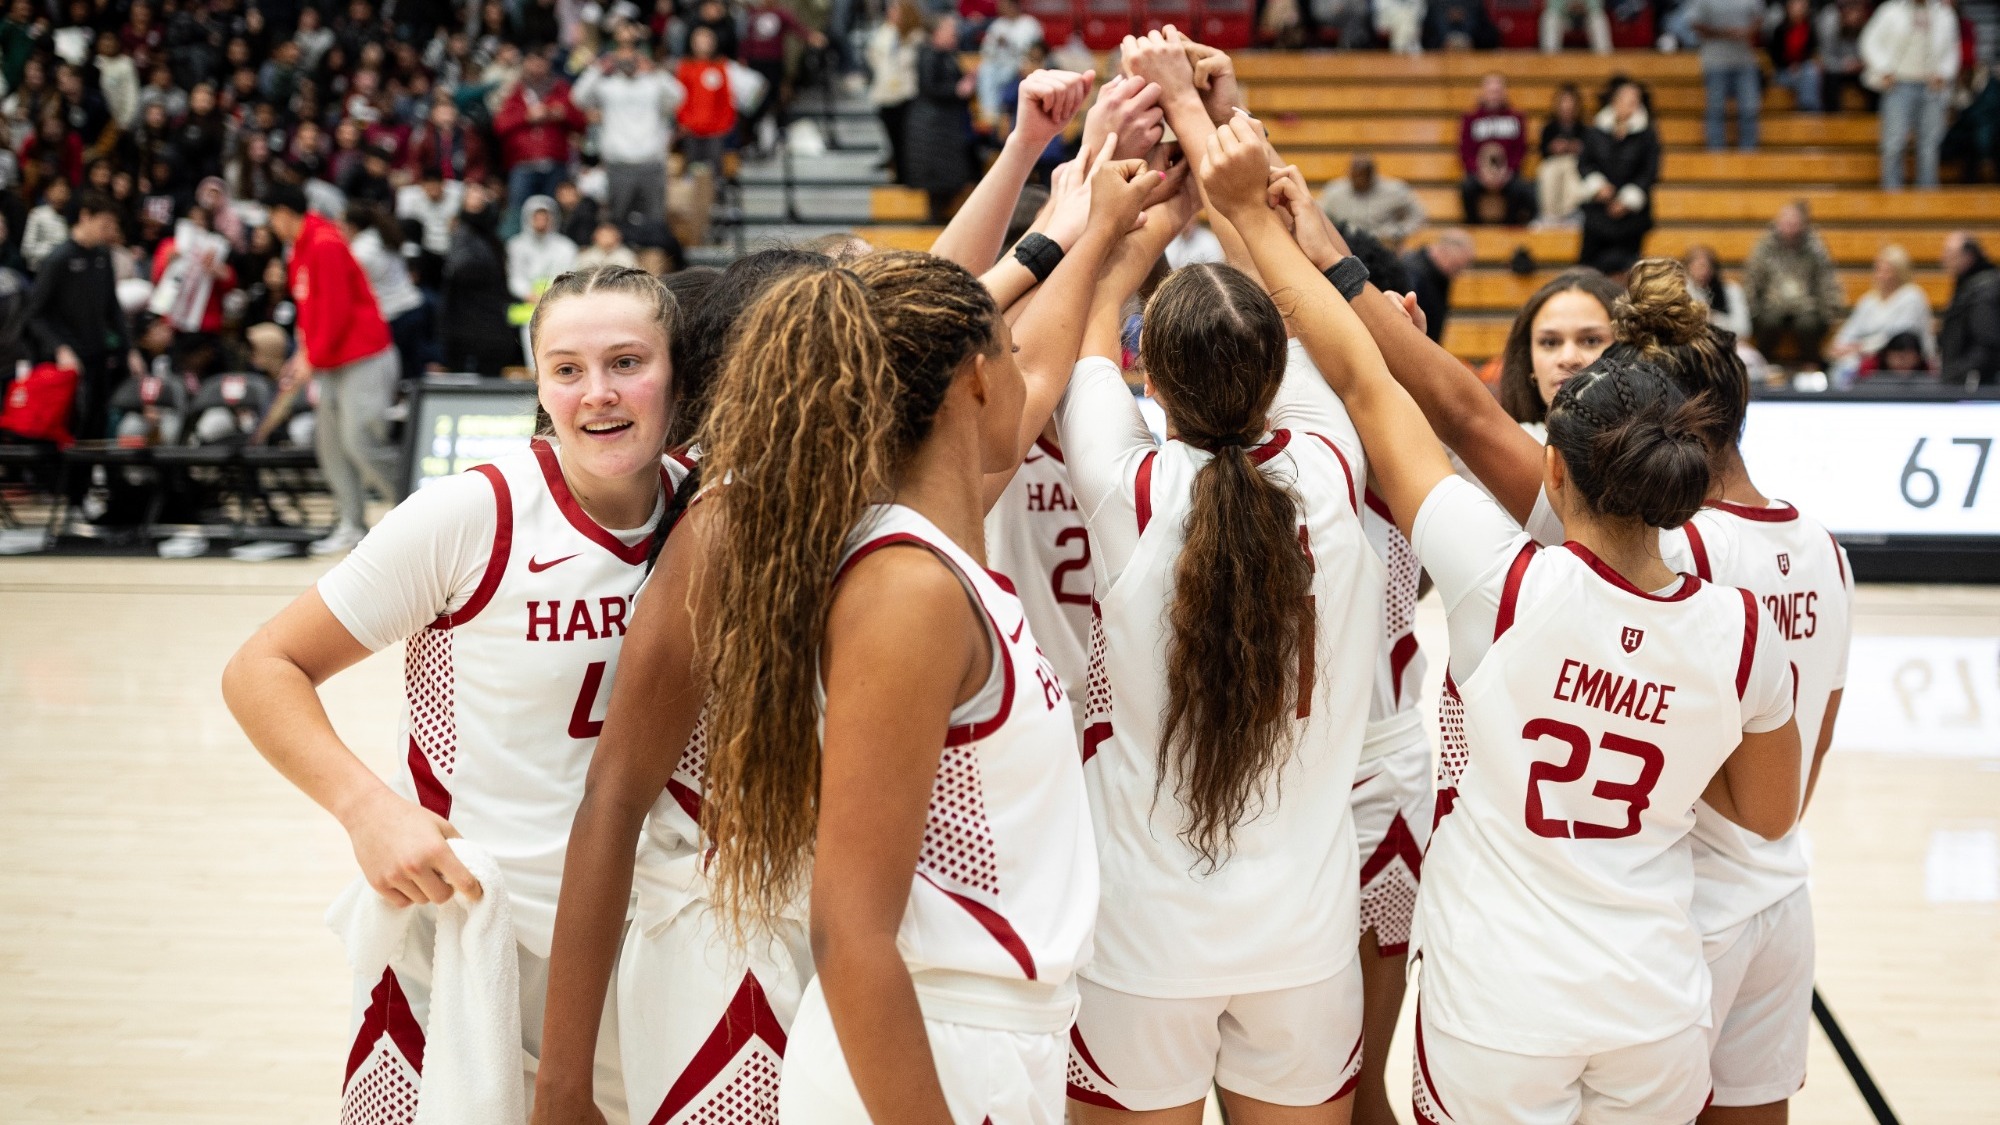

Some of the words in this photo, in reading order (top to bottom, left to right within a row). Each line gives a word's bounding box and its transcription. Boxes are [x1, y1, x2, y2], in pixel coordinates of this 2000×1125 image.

[1901, 437, 1993, 508] 67
[1051, 527, 1092, 606] 2
[526, 595, 635, 642] HAR
[1762, 591, 1818, 641] ONES
[1553, 658, 1676, 725] EMNACE
[1522, 717, 1665, 839] 23
